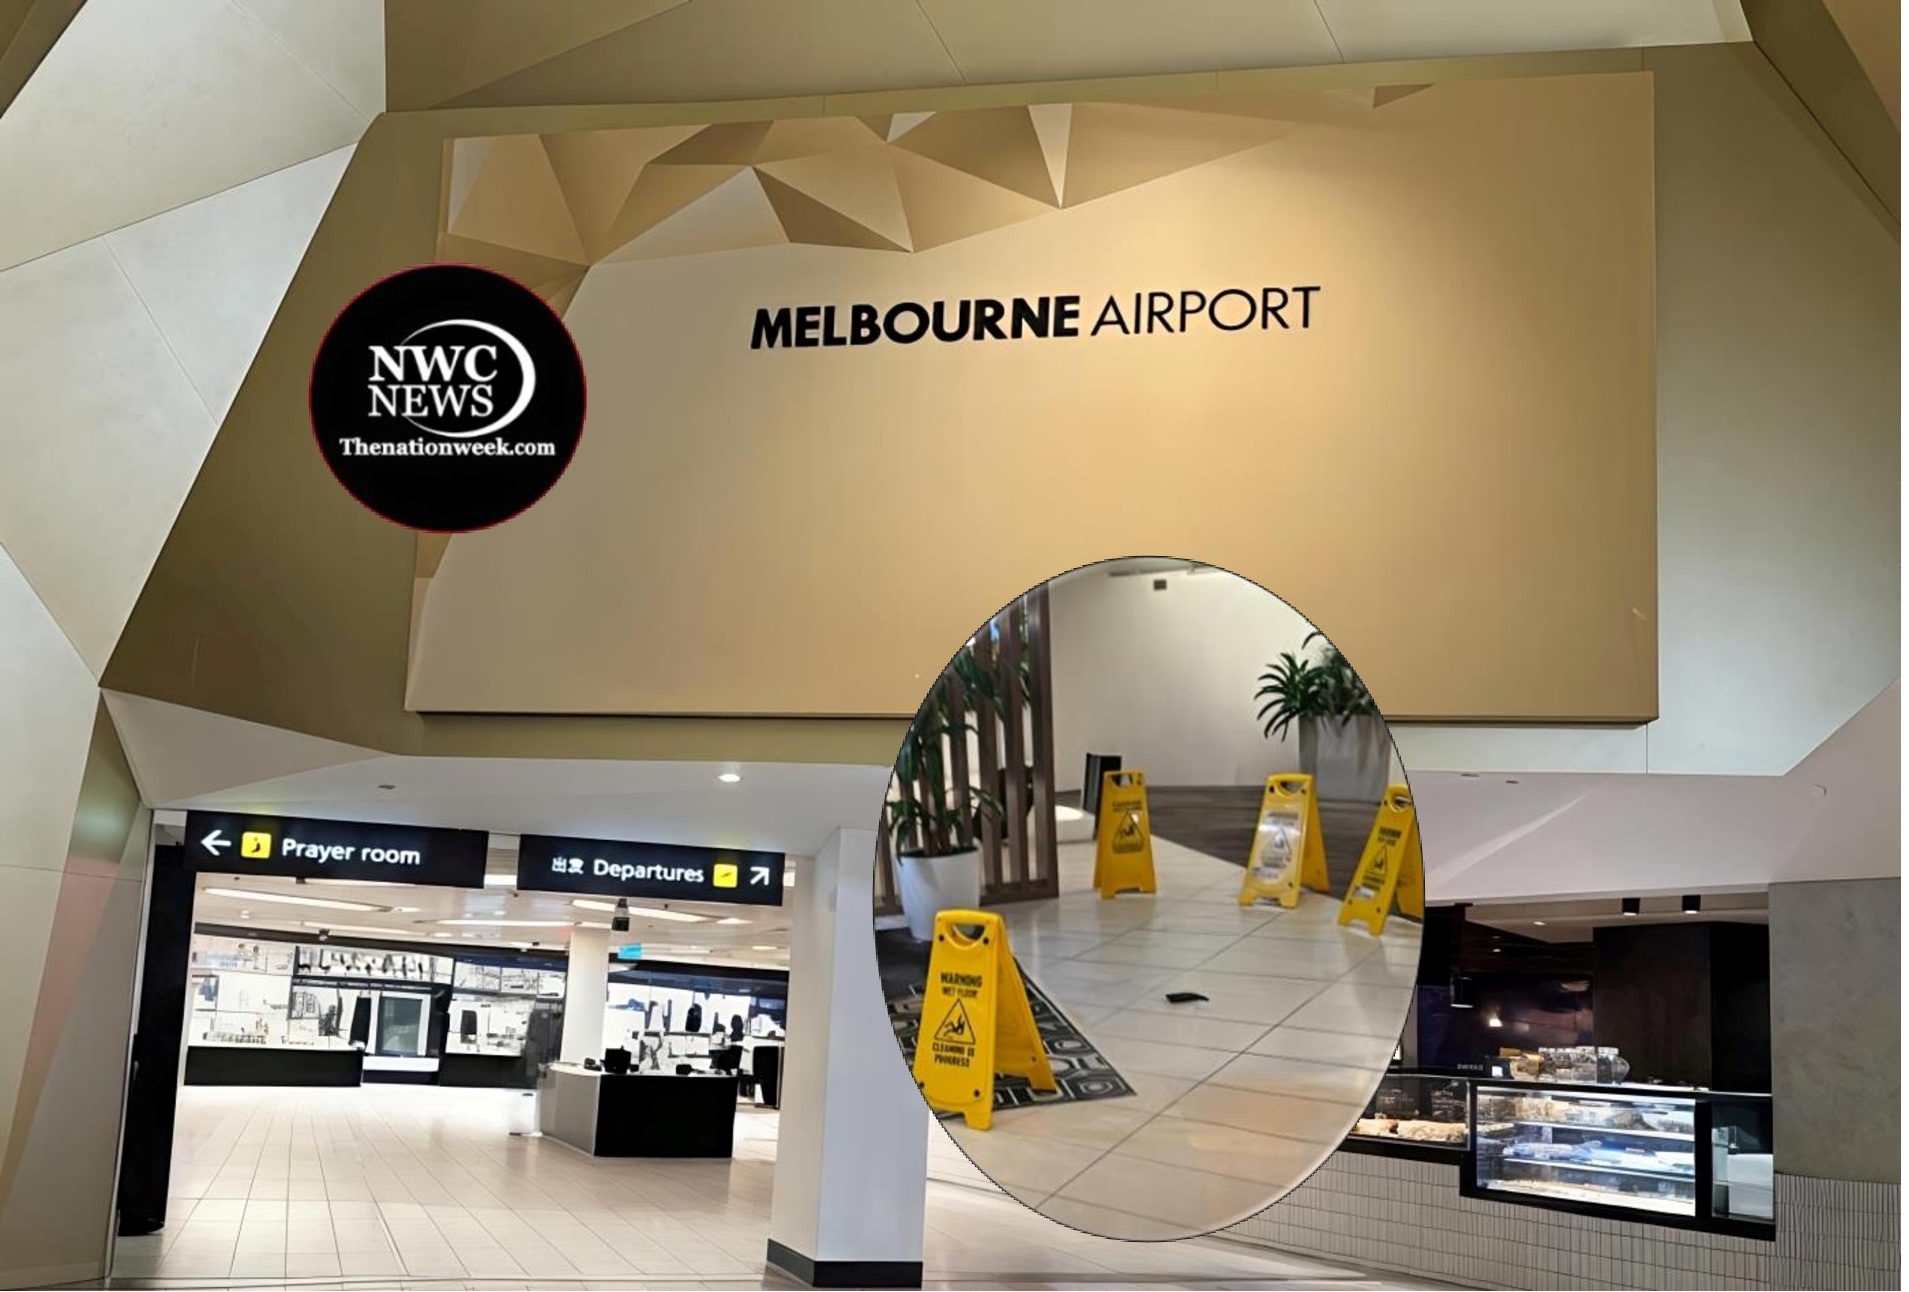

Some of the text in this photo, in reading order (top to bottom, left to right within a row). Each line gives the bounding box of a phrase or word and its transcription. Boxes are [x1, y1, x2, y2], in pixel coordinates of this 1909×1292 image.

[751, 286, 1321, 349] MELBOURNE AIRPORT
[282, 838, 421, 865] Prayer room
[593, 858, 704, 883] Departures
[940, 972, 982, 988] WARNING
